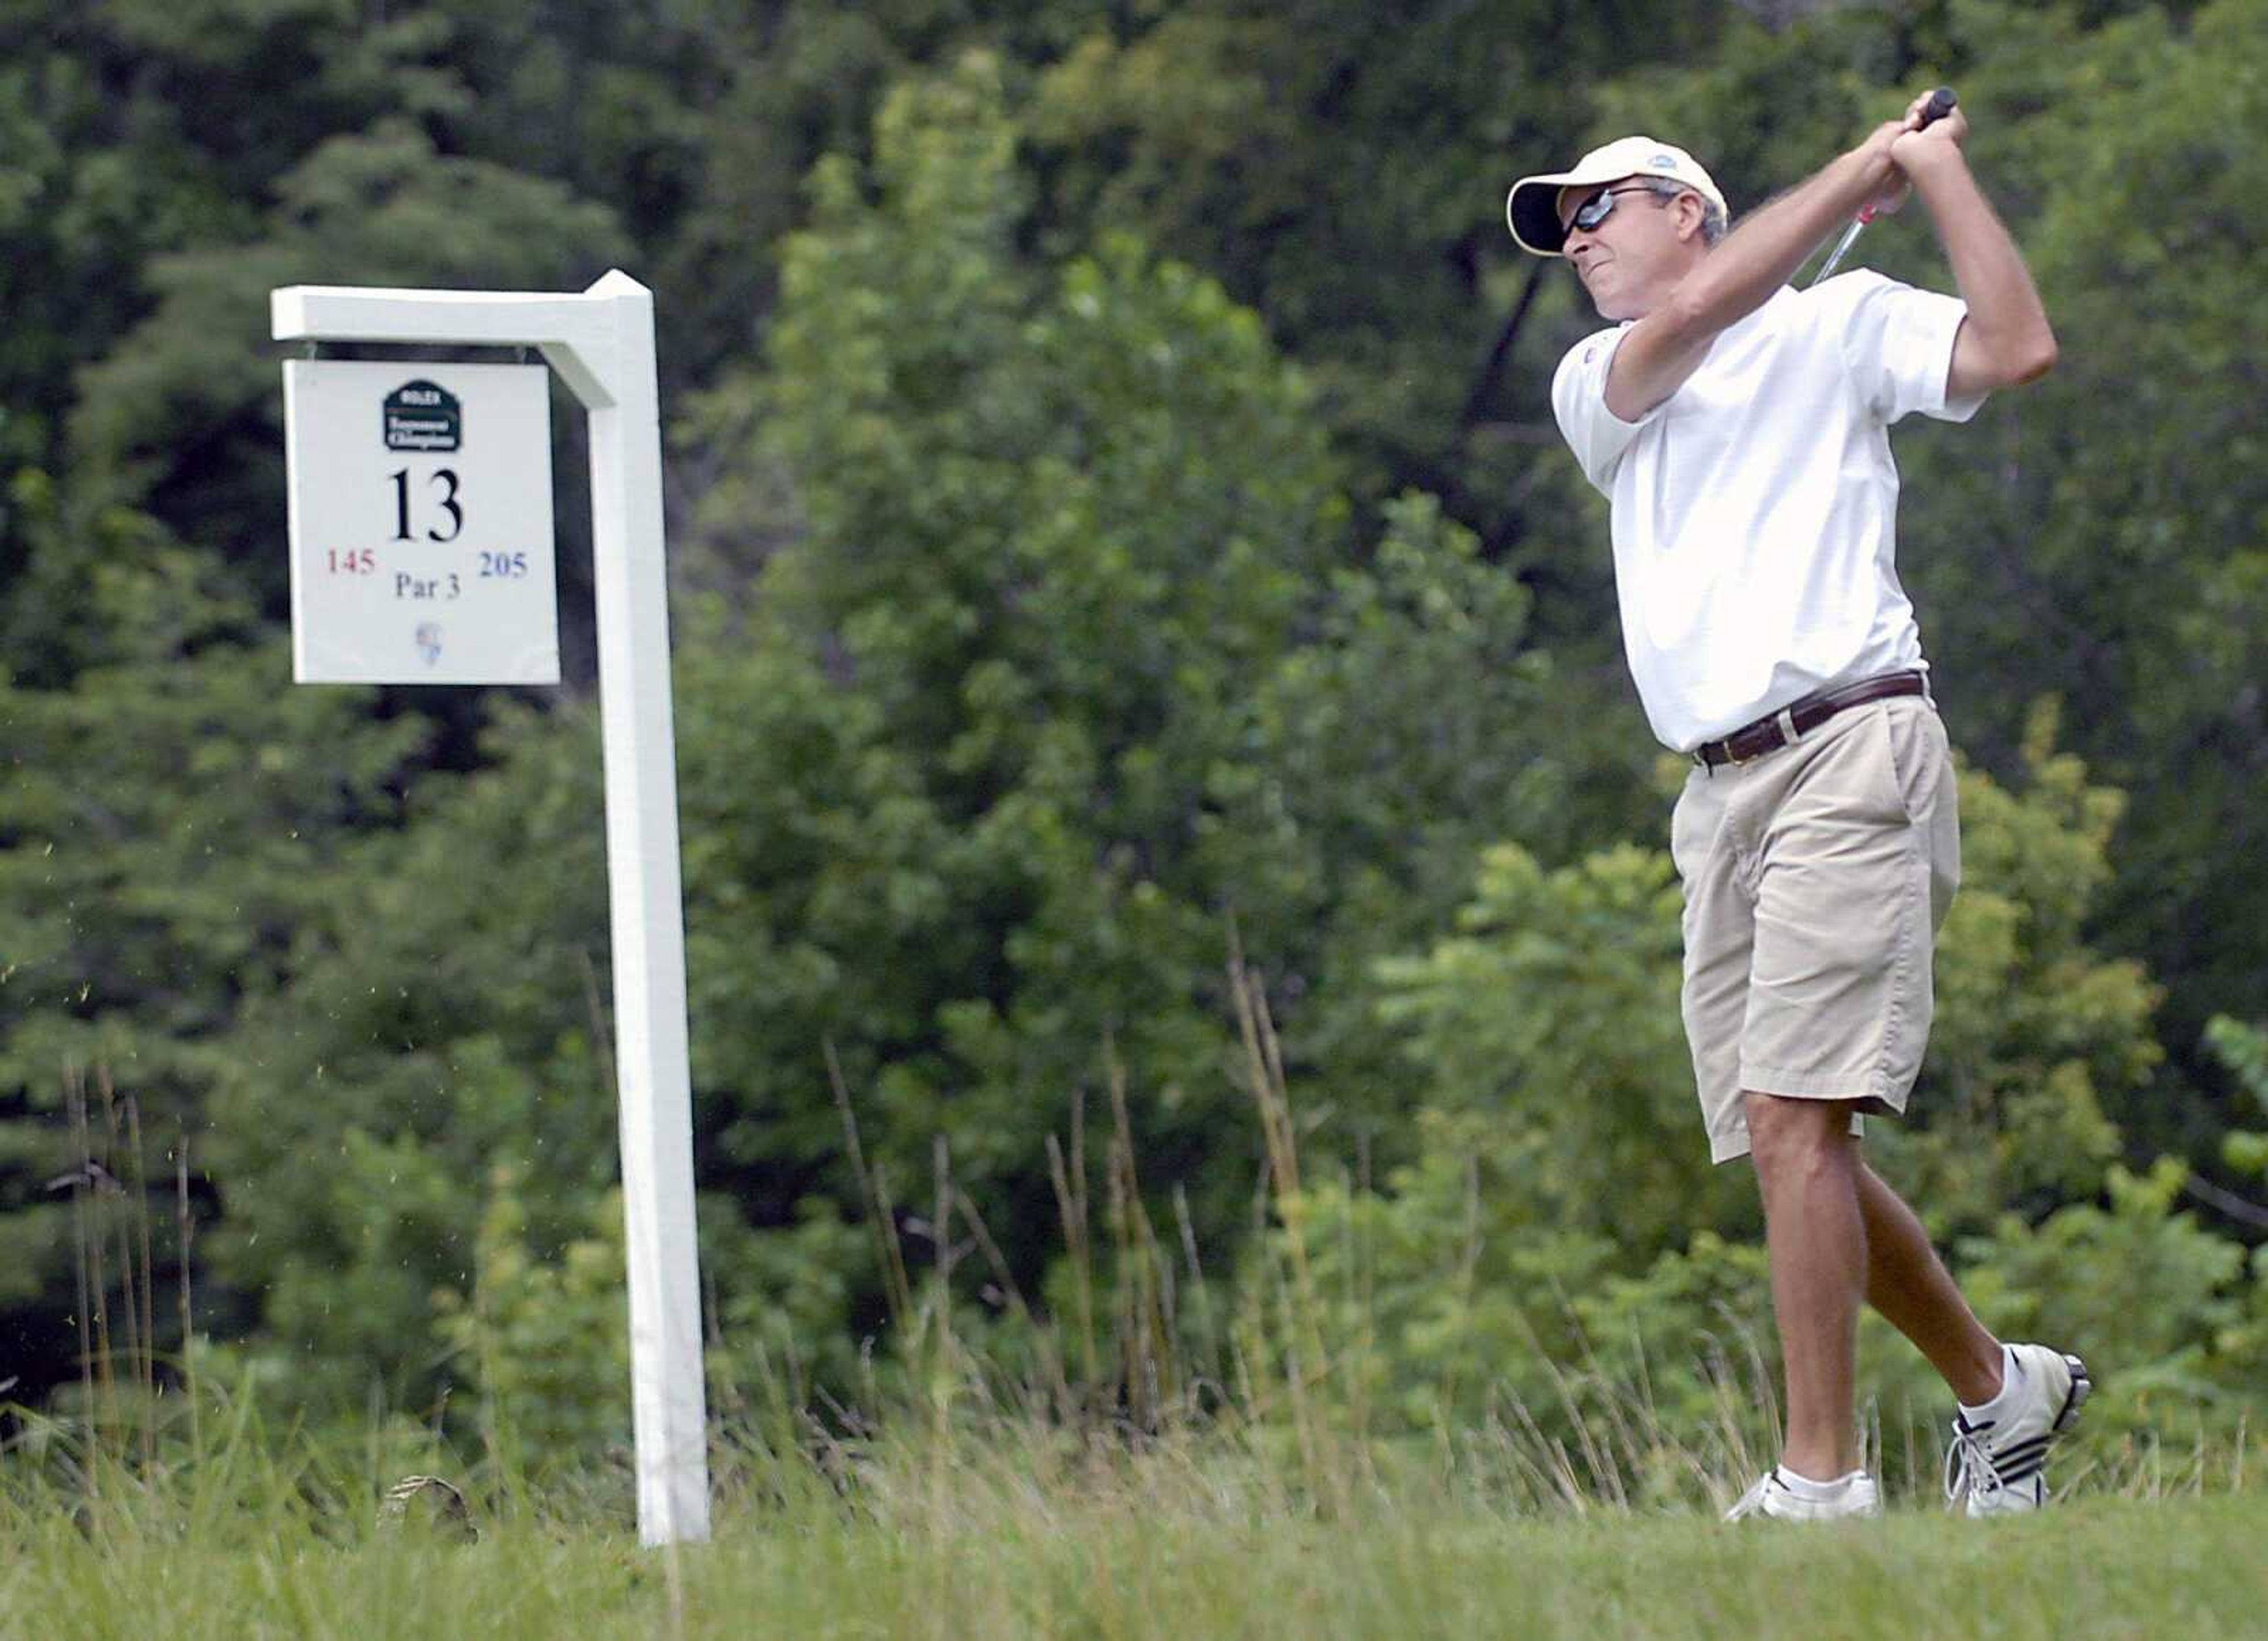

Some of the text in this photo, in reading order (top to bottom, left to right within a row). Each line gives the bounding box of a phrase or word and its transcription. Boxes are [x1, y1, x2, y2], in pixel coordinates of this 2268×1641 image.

[388, 467, 463, 542] 13
[328, 549, 374, 575] 145
[480, 551, 527, 578] 205
[396, 573, 461, 599] Par 3
